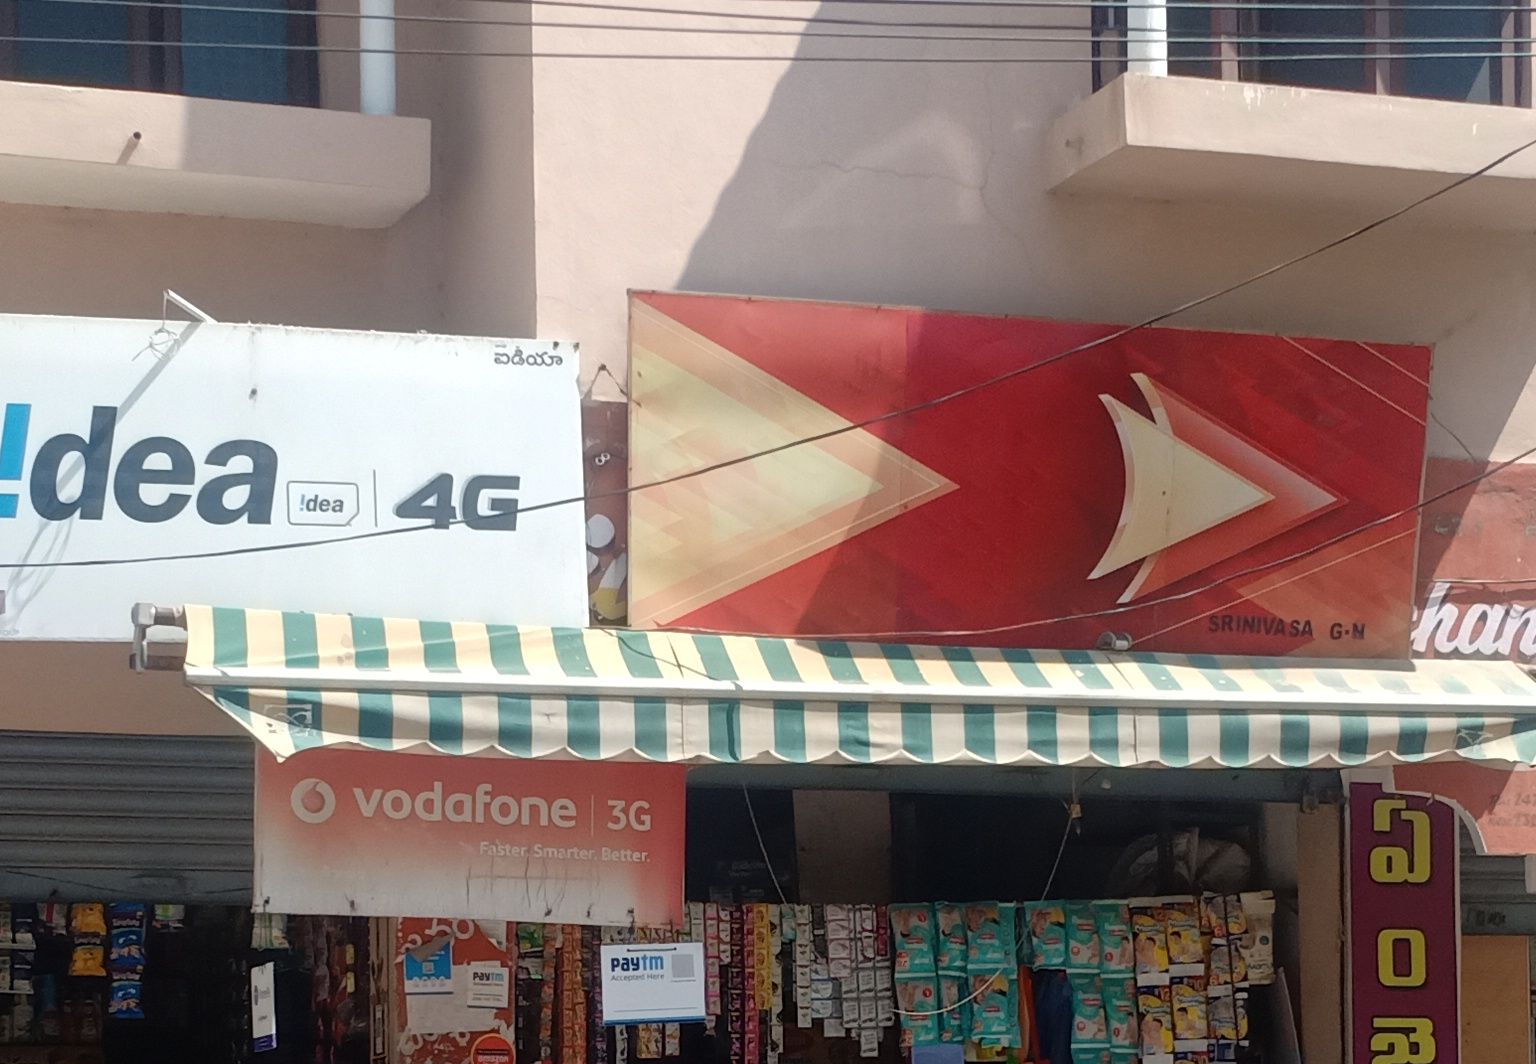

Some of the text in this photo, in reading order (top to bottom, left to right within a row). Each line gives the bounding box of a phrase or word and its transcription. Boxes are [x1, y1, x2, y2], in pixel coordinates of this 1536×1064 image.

[395, 474, 520, 532] 4G
[1208, 614, 1314, 638] SRINIVASA
[353, 781, 652, 832] vodafone 3G
[601, 846, 651, 863] Better.
